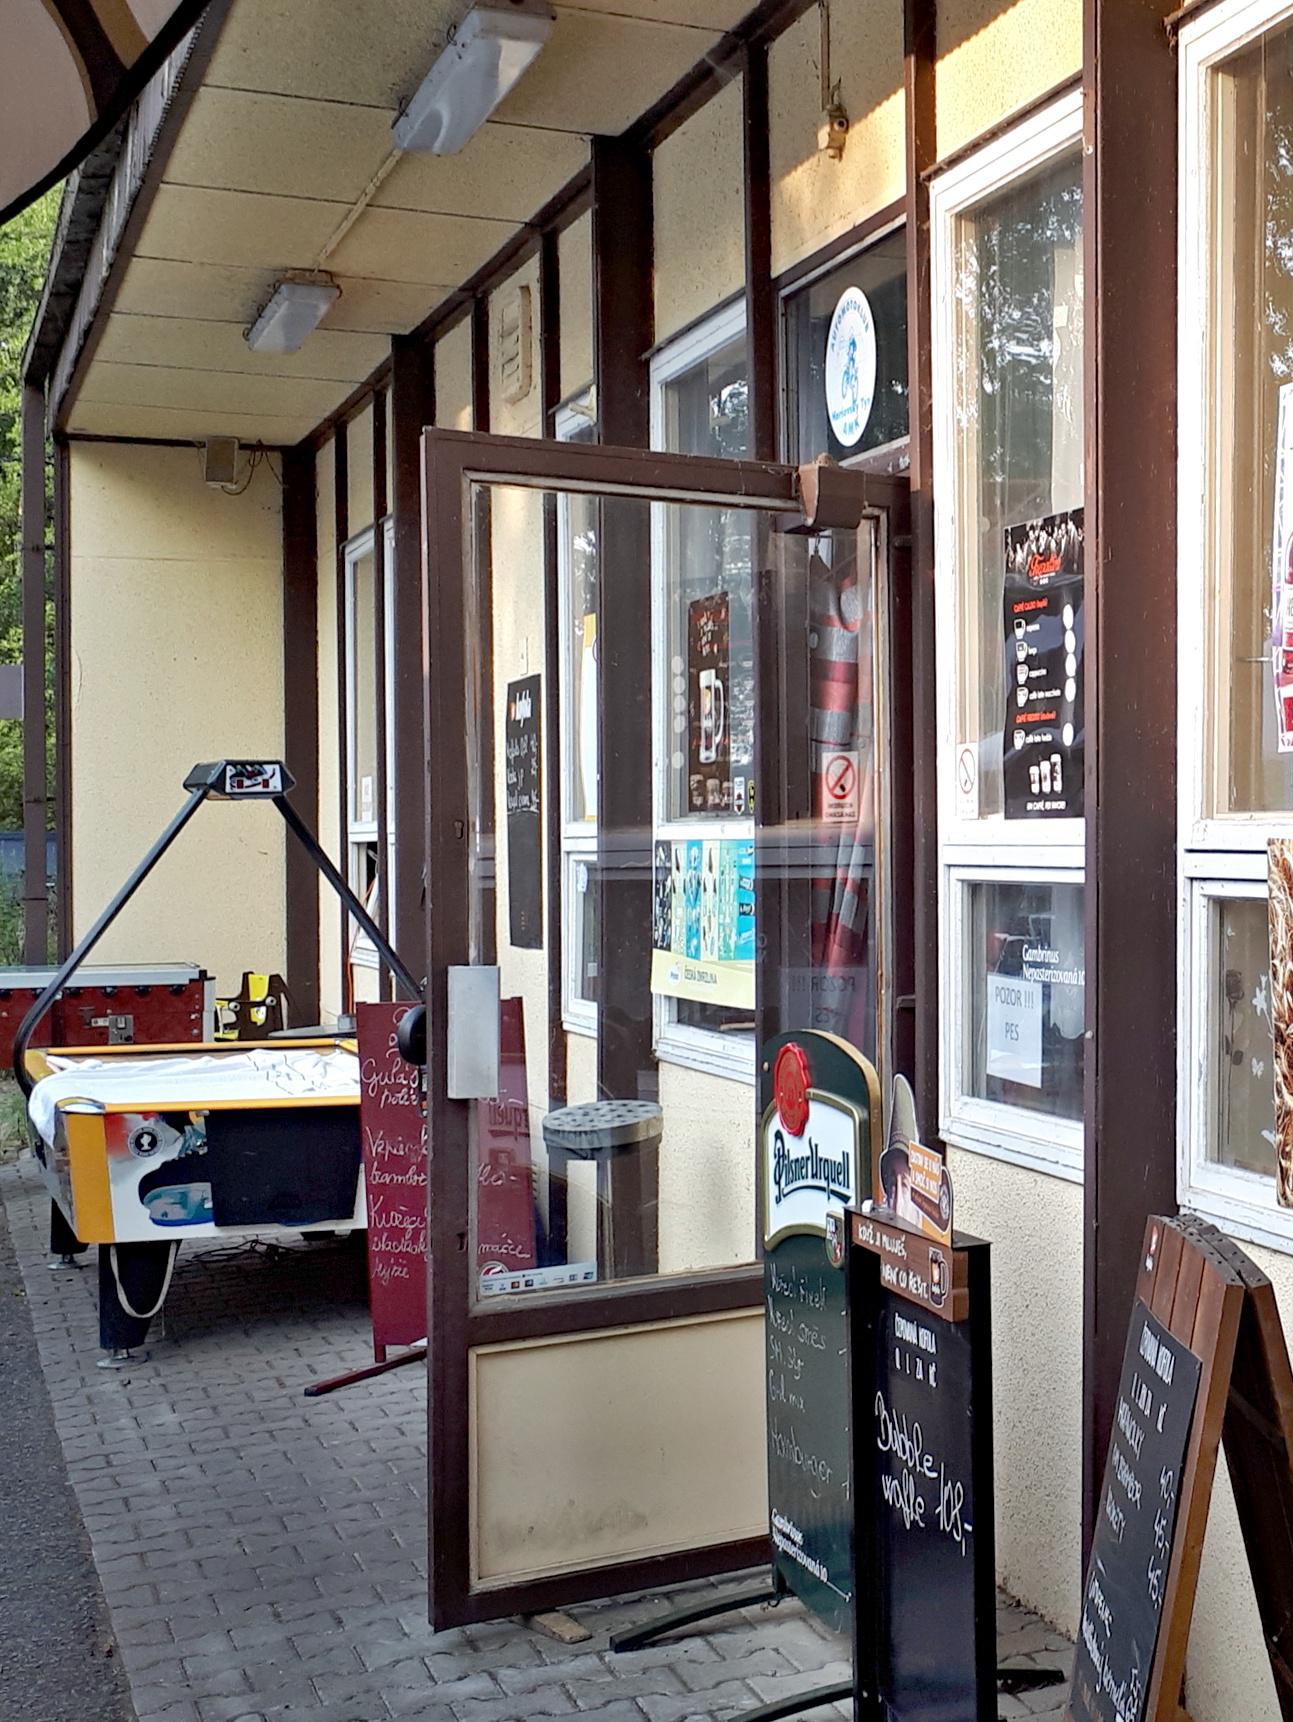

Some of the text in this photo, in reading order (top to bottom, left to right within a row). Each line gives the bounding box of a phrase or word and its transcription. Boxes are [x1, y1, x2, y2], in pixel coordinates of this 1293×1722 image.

[1022, 944, 1059, 965] Gambrinus
[1023, 962, 1078, 985] Nepasterizovaná
[995, 986, 1035, 1009] POZOR !!!
[1005, 1021, 1020, 1042] PES
[774, 1129, 850, 1205] Pilsner Urquell
[918, 1326, 937, 1355] KOFOLA
[916, 1357, 924, 1380] ZA
[875, 1391, 938, 1478] Bubble
[882, 1468, 925, 1530] waffle
